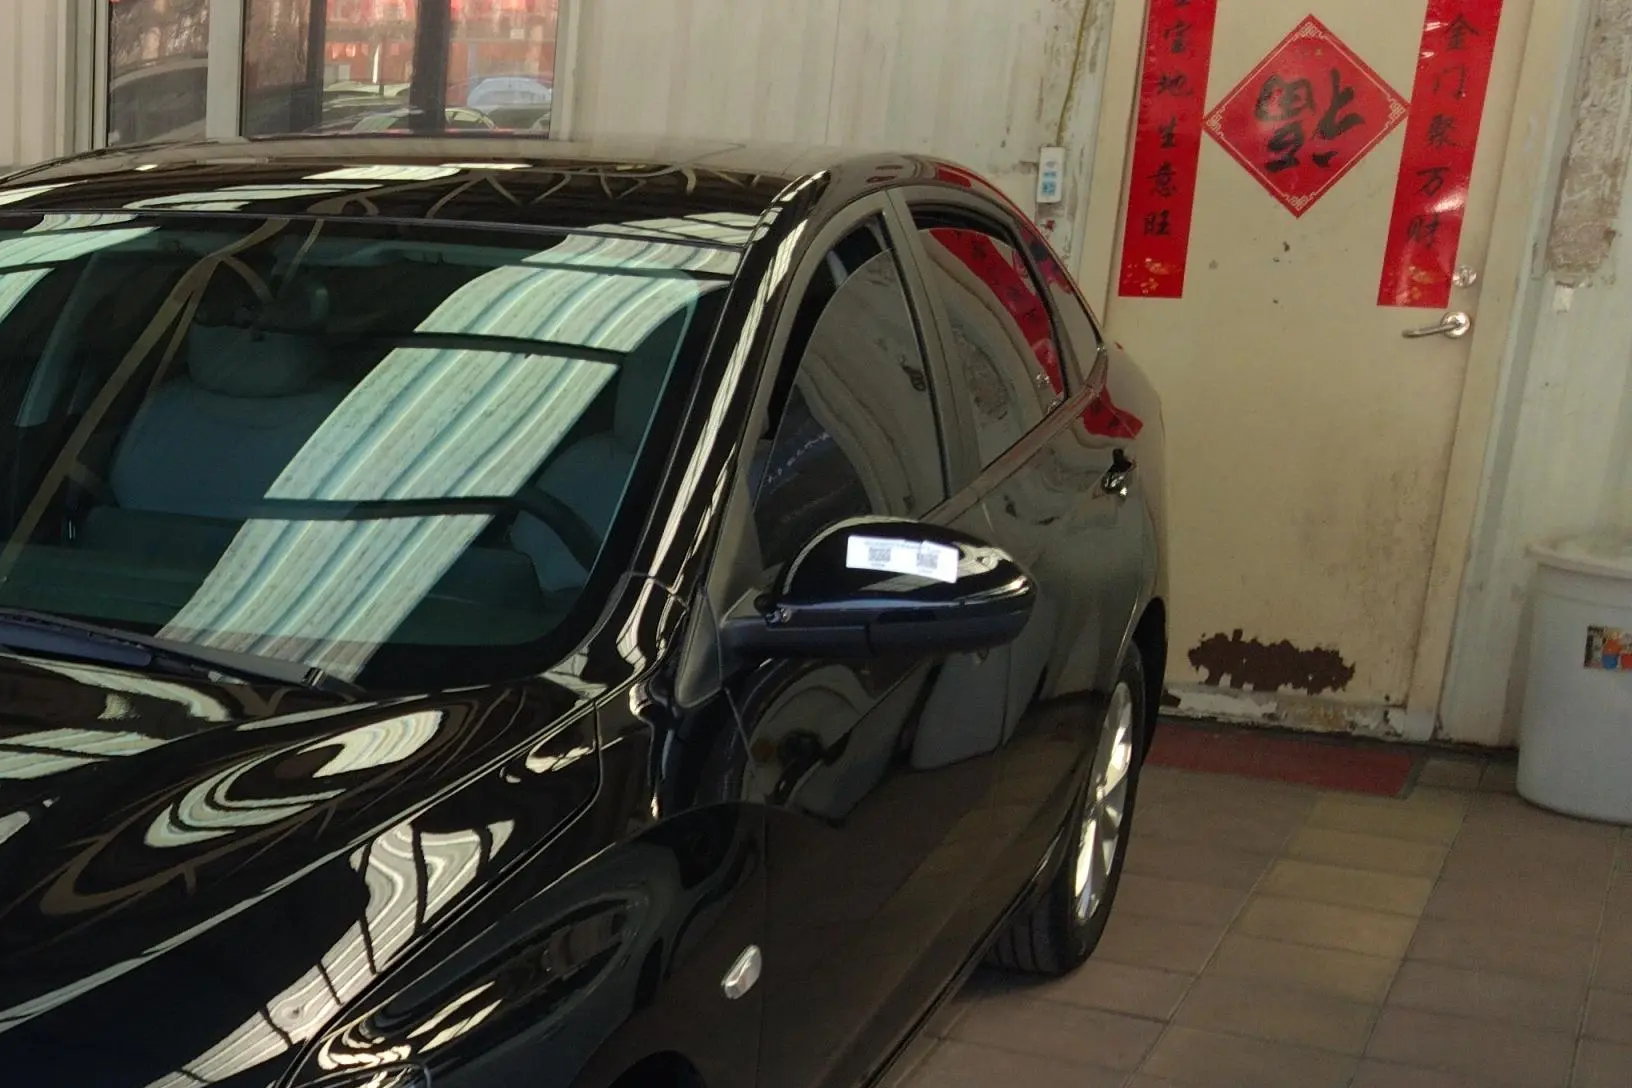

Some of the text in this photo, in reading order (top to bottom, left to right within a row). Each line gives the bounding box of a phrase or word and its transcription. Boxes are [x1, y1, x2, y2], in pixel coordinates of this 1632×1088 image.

[1143, 0, 1194, 238] 宝地生意旺
[1253, 67, 1367, 173] 福
[1406, 13, 1480, 248] 金门聚万财
